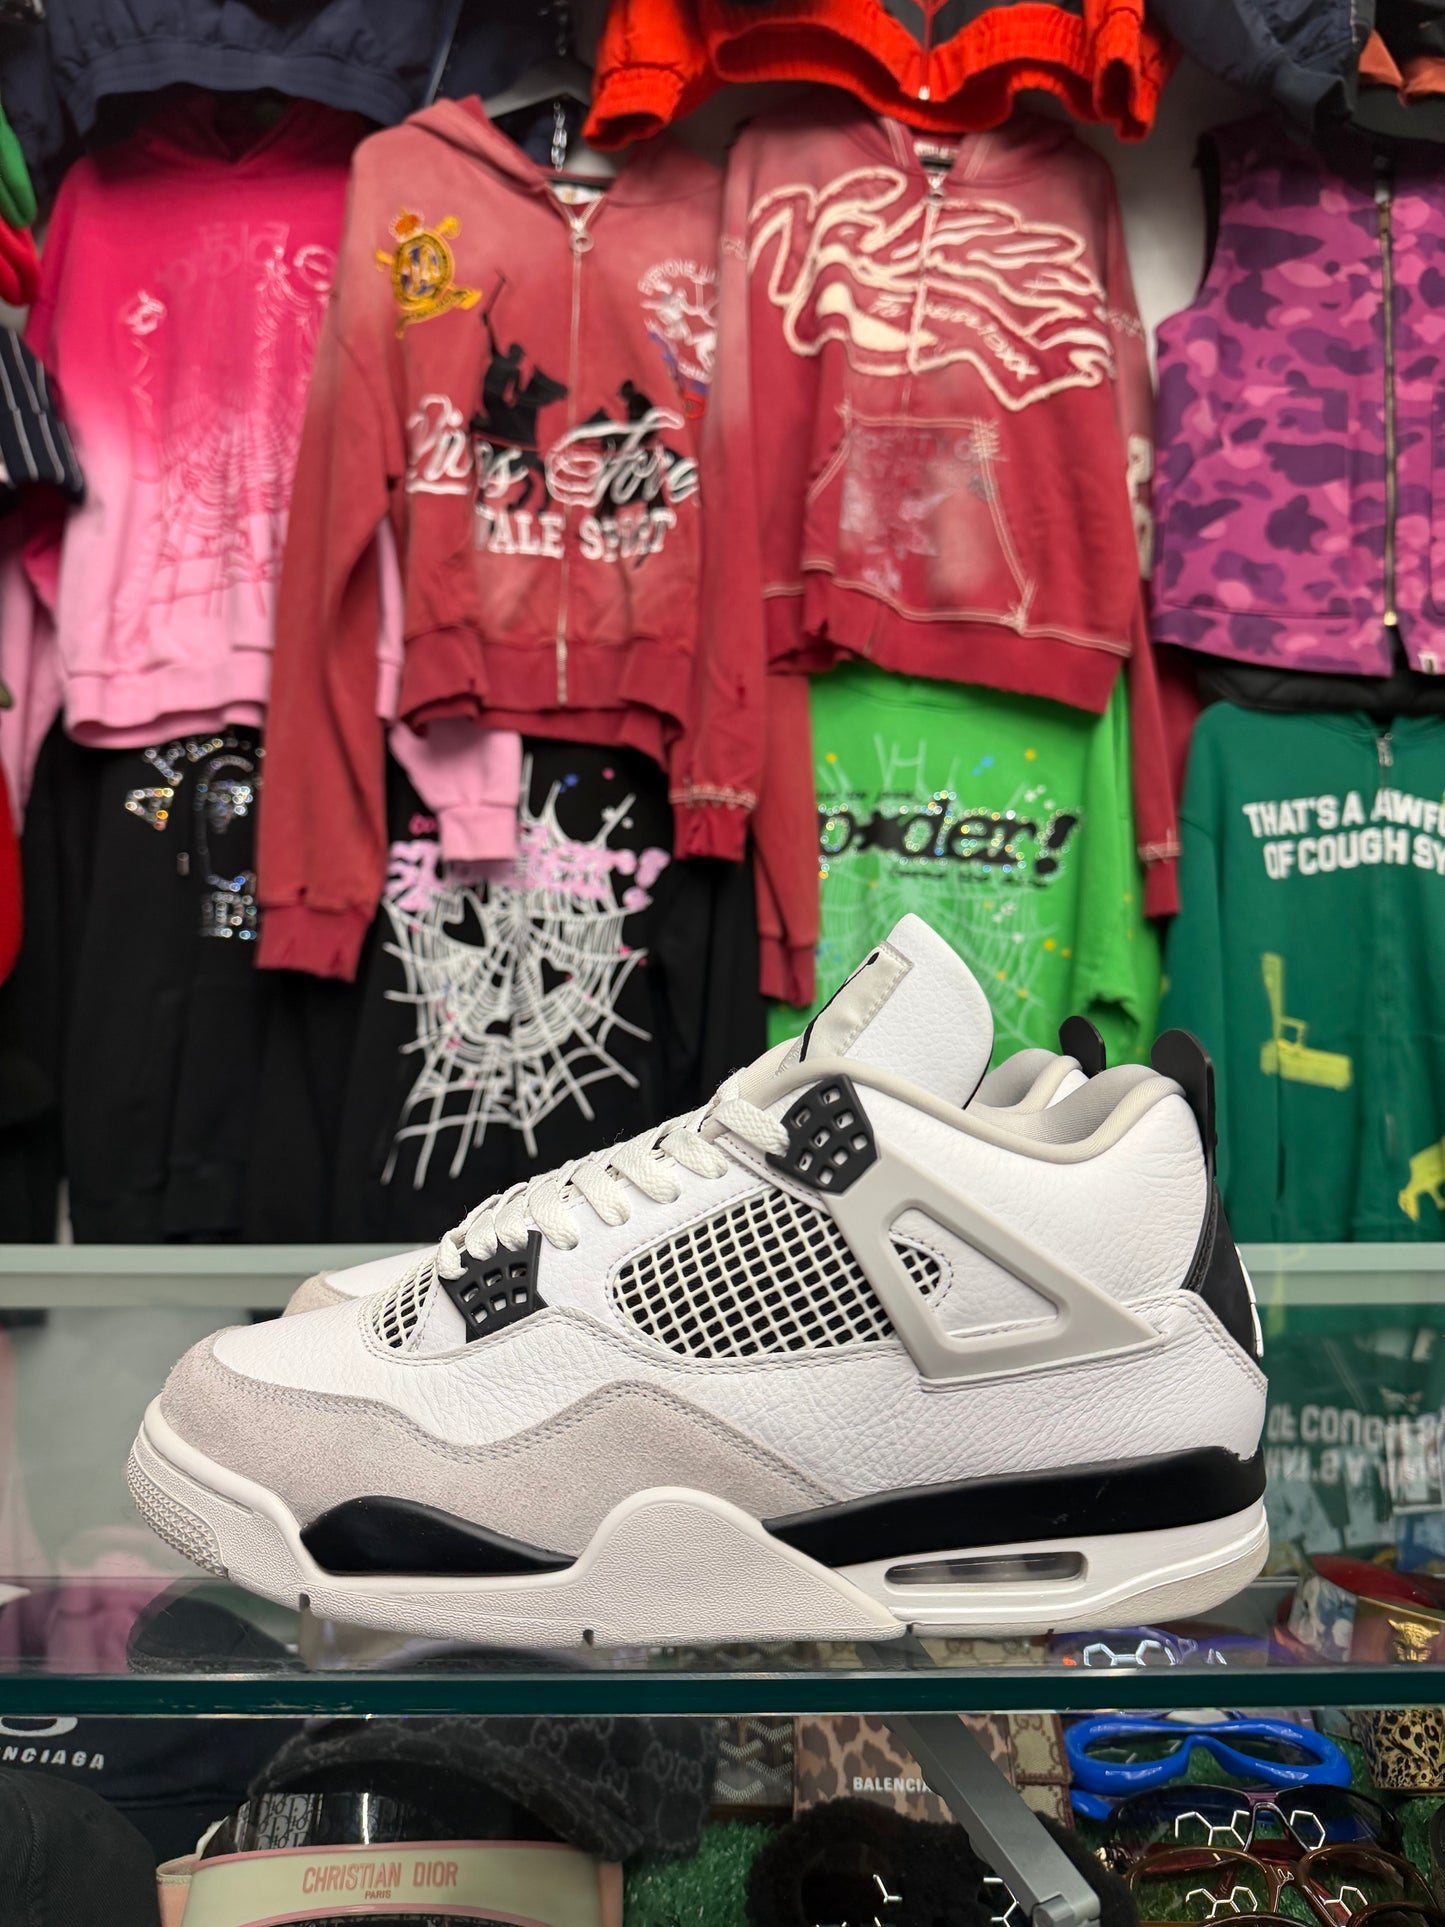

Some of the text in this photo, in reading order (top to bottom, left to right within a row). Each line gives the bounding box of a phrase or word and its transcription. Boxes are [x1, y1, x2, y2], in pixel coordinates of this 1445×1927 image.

[1243, 794, 1339, 838] THAT'S
[1341, 790, 1365, 827] A
[1263, 841, 1295, 879] OF
[1298, 826, 1410, 875] COUGH
[302, 1860, 459, 1894] CHRISTIAN DIOR
[364, 1889, 391, 1900] PARIS
